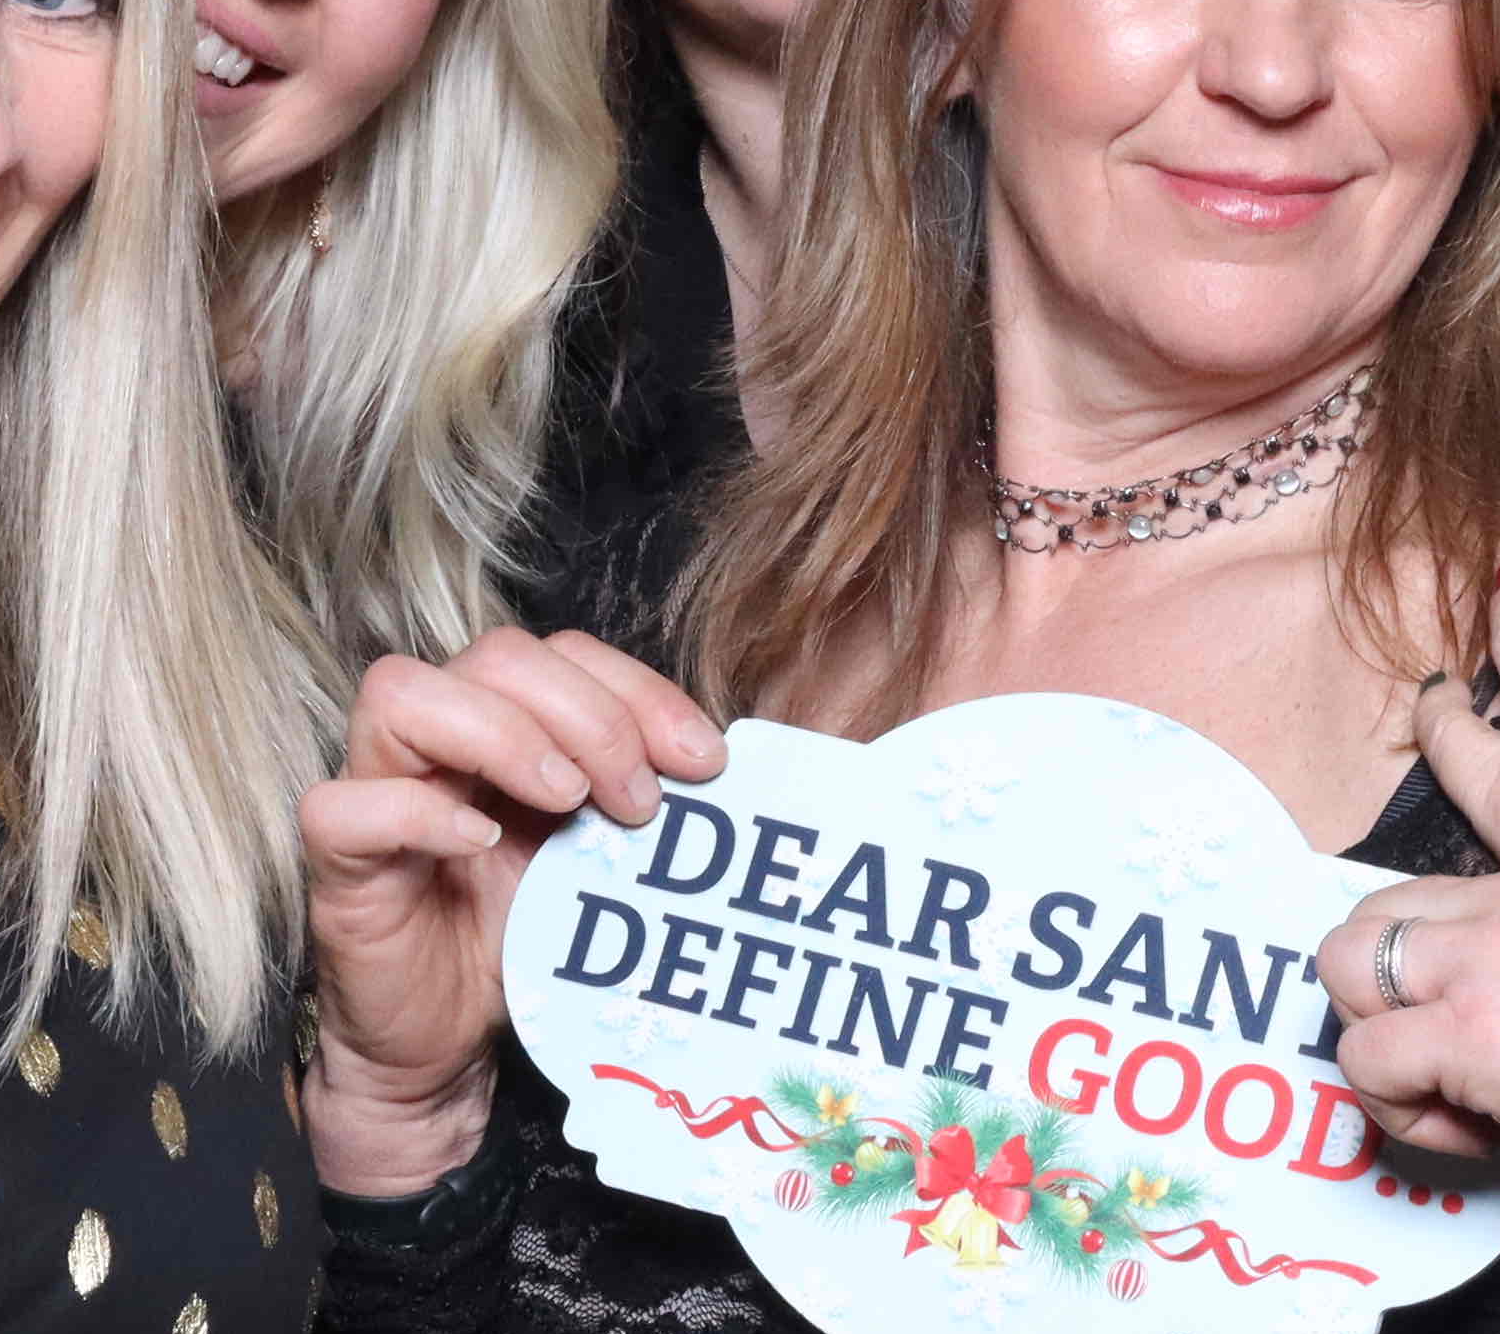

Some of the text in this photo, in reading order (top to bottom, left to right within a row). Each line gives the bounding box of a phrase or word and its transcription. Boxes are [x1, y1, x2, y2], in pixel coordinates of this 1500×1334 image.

[636, 793, 992, 969] DEAR
[552, 892, 1464, 1214] DEFINE GOOD...
